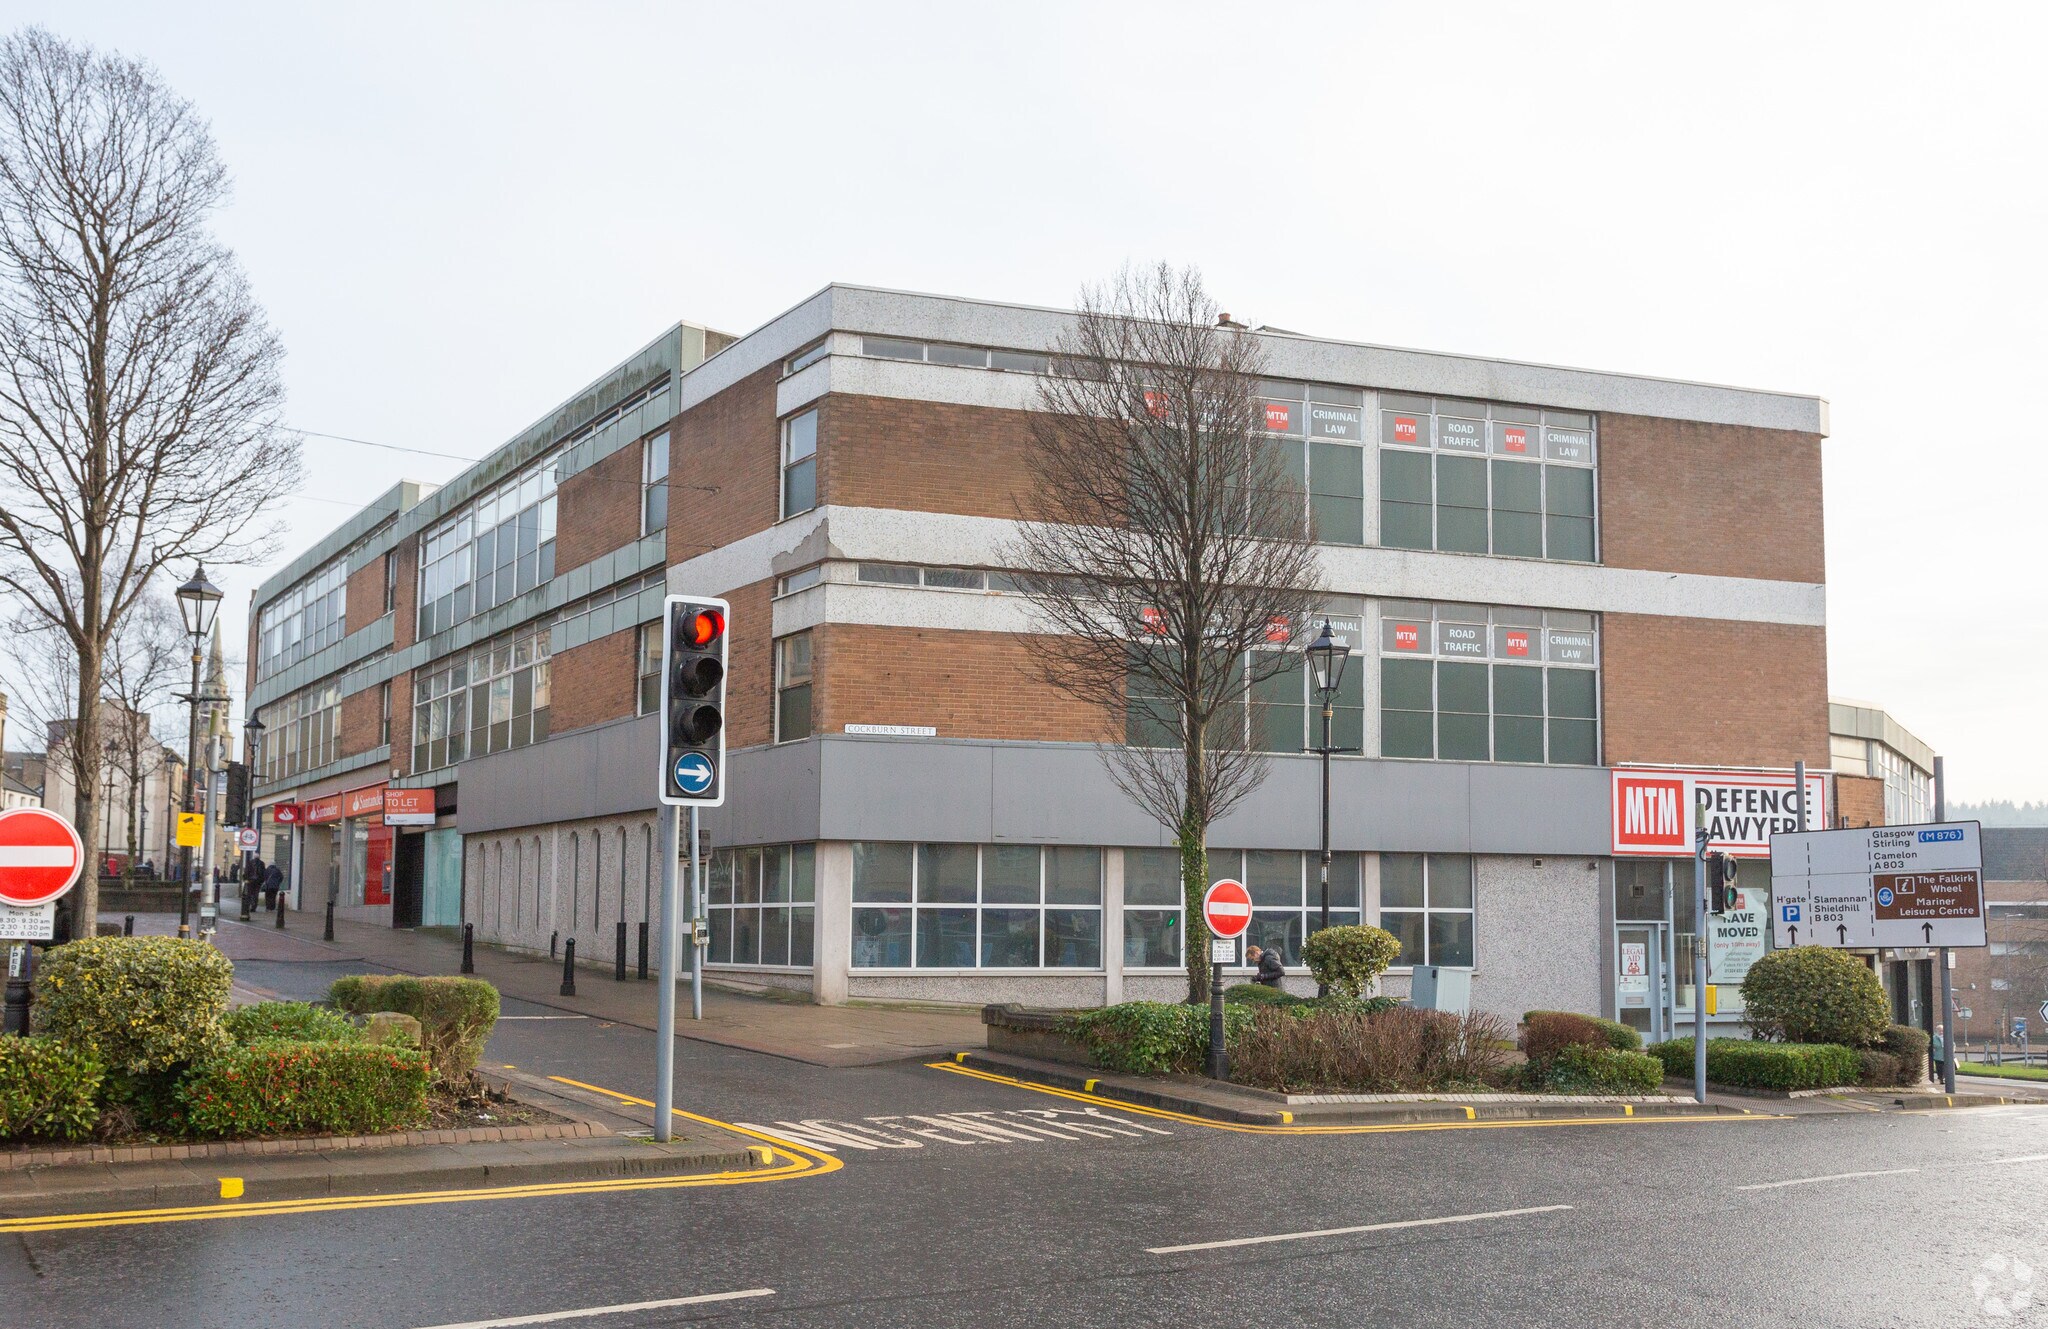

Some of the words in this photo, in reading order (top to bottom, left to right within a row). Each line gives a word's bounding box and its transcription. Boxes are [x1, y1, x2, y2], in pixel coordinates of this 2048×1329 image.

[1266, 410, 1288, 421] MTM
[1312, 409, 1358, 422] CRIMINAL
[1325, 424, 1346, 435] LAW
[1395, 423, 1416, 434] MTM
[1448, 423, 1474, 434] ROAD
[1443, 435, 1480, 448] TRAFFIC
[1505, 434, 1526, 444] MTM
[1547, 433, 1589, 446] CRIMINAL
[1559, 447, 1579, 457] LAW
[1312, 619, 1359, 632] CRMINAL
[1396, 631, 1417, 641] MTM
[1449, 629, 1475, 639] ROAD
[1507, 638, 1528, 648] MTM
[1550, 635, 1592, 647] CRIMINAL
[1444, 642, 1481, 653] TRAFFIC
[1561, 650, 1581, 659] LAW
[848, 725, 897, 734] COCKBURN
[900, 727, 933, 735] STREET
[386, 798, 399, 807] TO
[401, 798, 418, 807] LET
[316, 802, 338, 818] Santander
[1625, 786, 1678, 835] MTM
[1709, 815, 1811, 841] AWYER
[1872, 830, 1915, 839] Glasgow
[1873, 839, 1910, 848] Stirling
[1874, 851, 1918, 860] Camelon
[1917, 875, 1935, 883] The
[1939, 874, 1974, 883] Falkirk
[1930, 884, 1962, 893] Wheel
[1777, 896, 1806, 904] H'gate
[1814, 896, 1867, 904] Slamannan
[1916, 897, 1956, 906] Mariner
[1814, 904, 1860, 913] Shieldhill
[1900, 908, 1936, 916] Leisure
[1939, 906, 1974, 915] Centre
[1786, 907, 1798, 921] P
[1717, 927, 1758, 937] MOVED
[733, 1119, 924, 1151] NO
